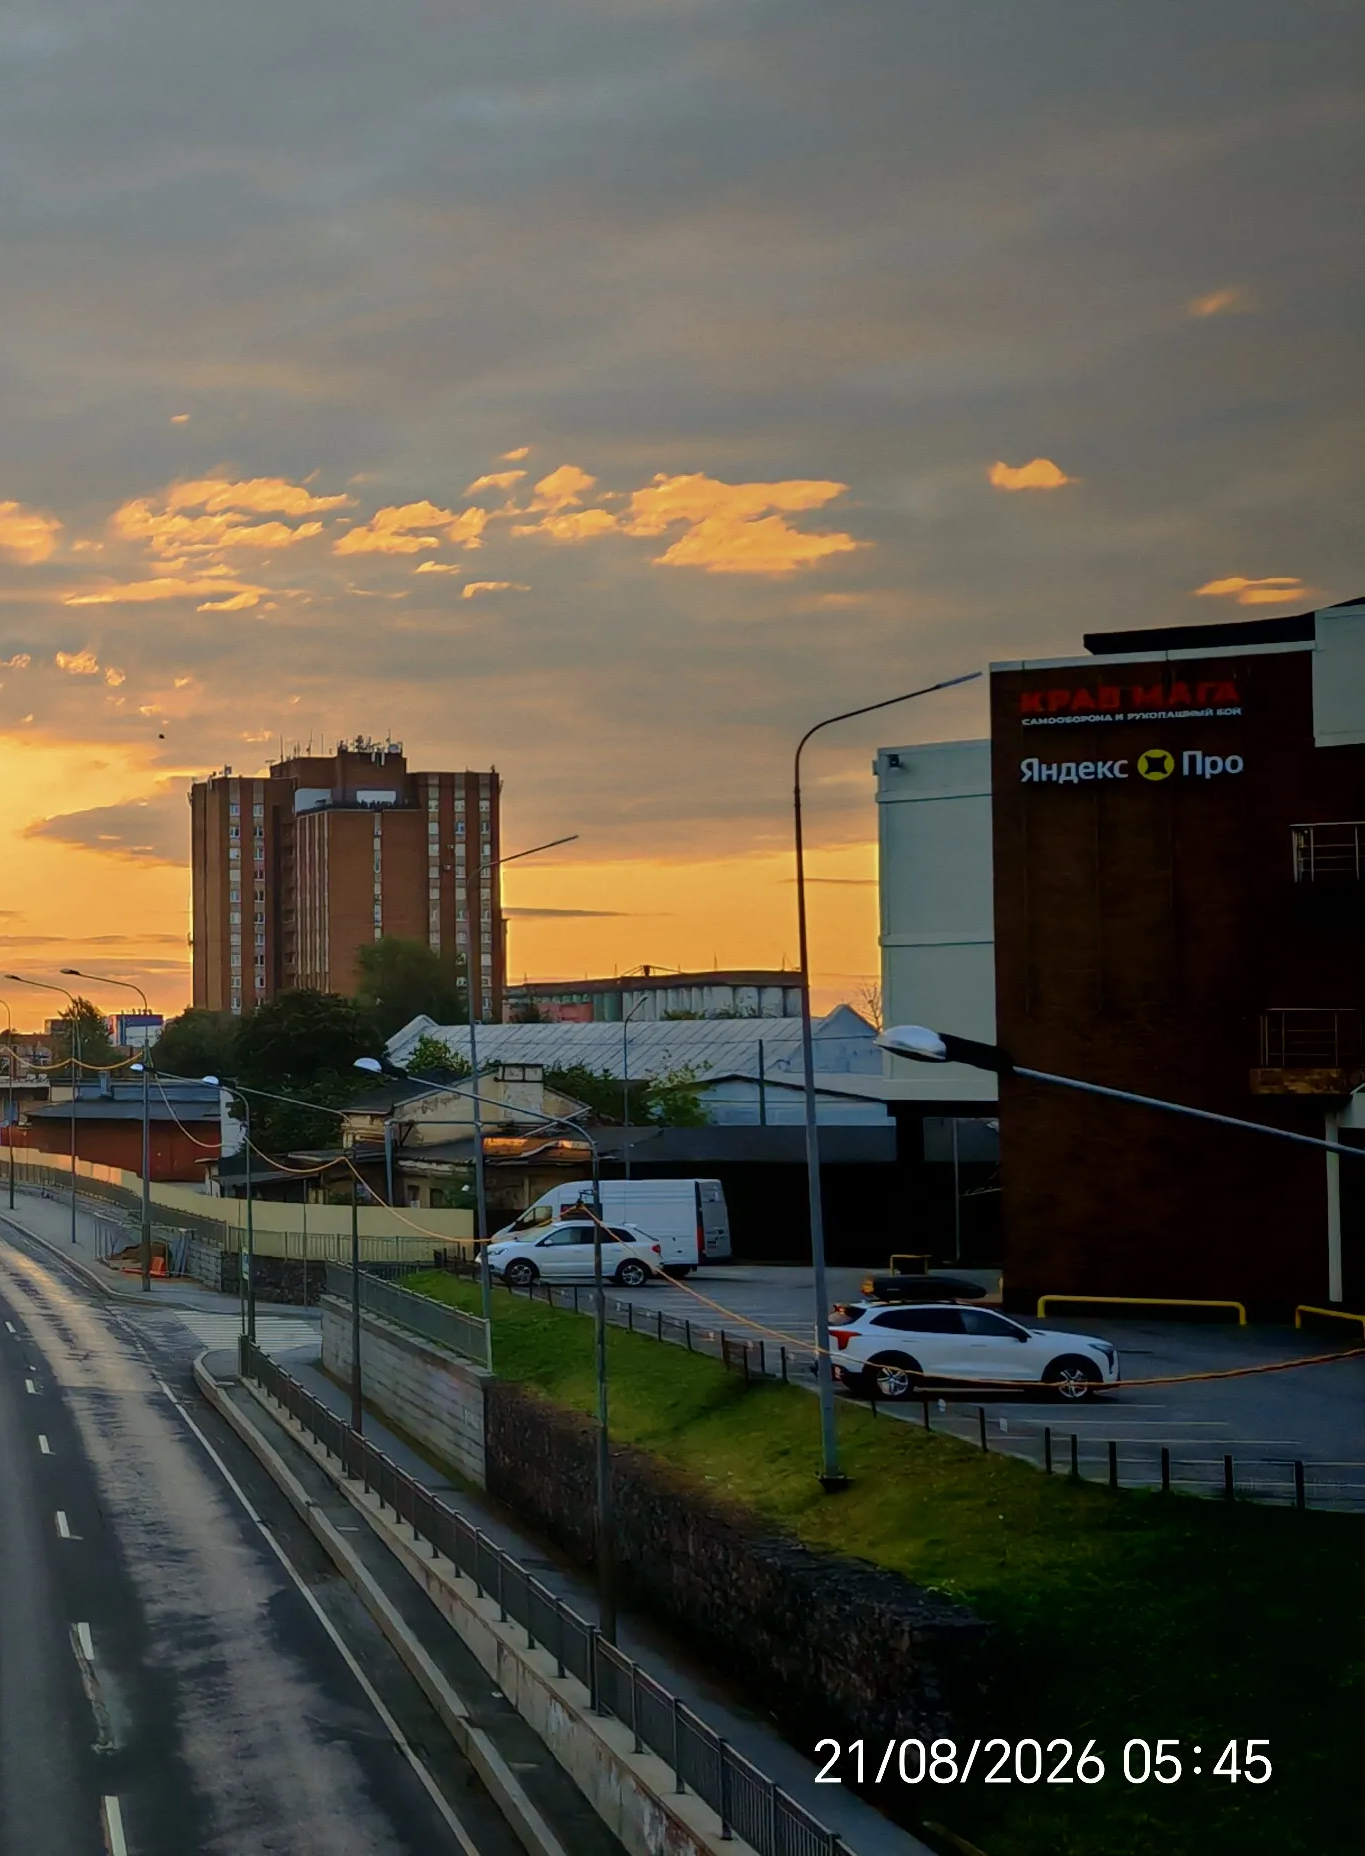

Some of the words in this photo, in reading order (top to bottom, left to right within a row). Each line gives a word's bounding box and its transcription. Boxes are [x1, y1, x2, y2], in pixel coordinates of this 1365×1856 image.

[1021, 713, 1113, 726] САМООБОРОНА
[1114, 713, 1124, 721] И
[1127, 708, 1214, 720] РУКОПАШНЫЙ
[1216, 706, 1243, 716] БОЙ
[1020, 757, 1129, 784] Яндекс
[1182, 750, 1244, 780] Про
